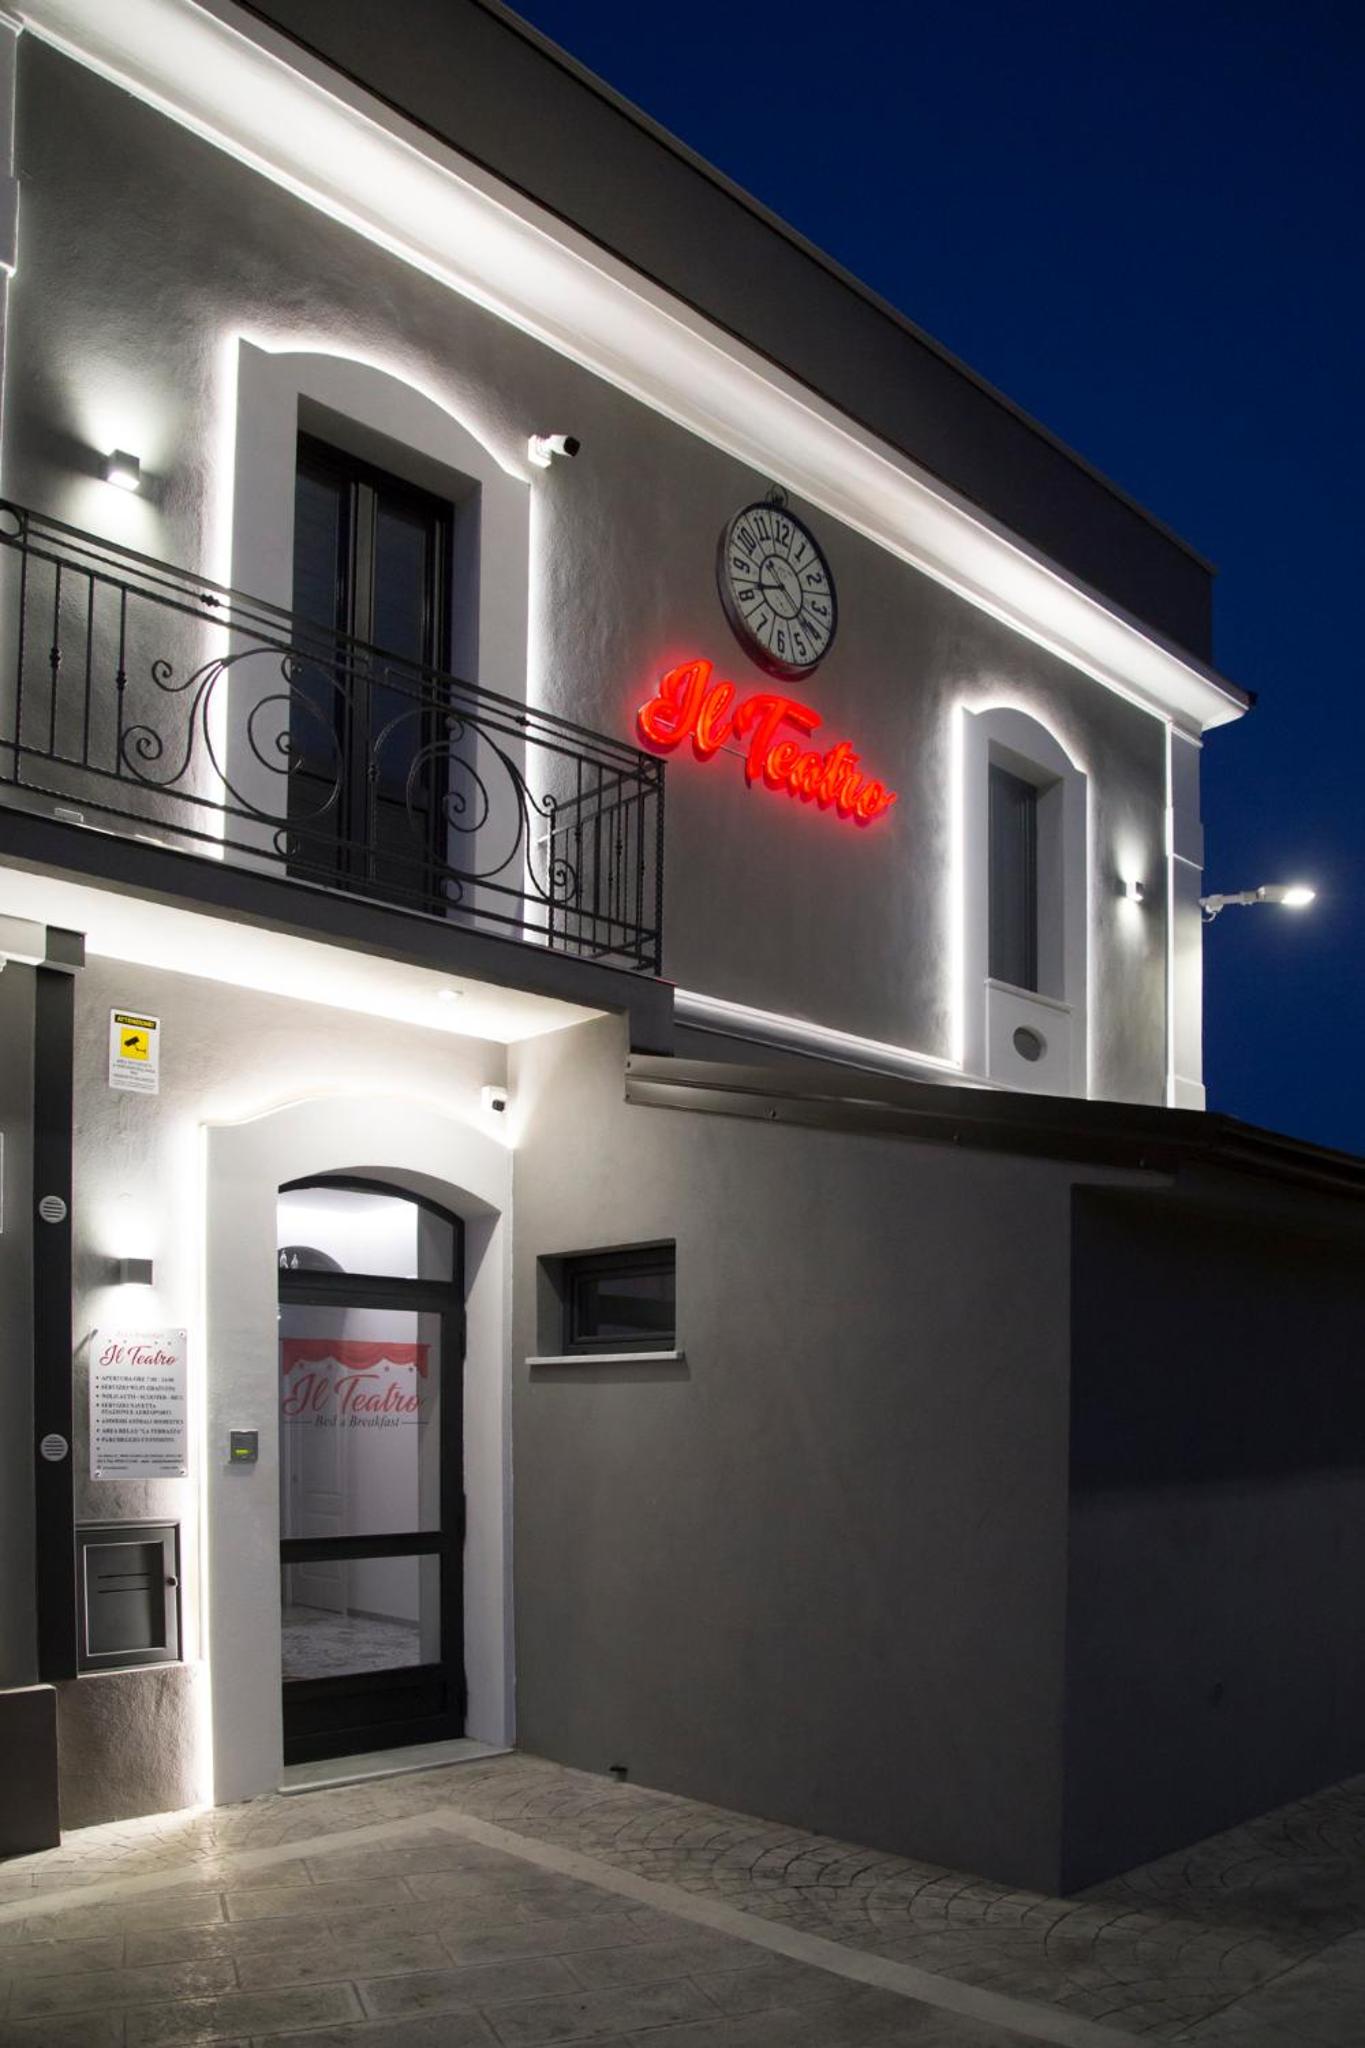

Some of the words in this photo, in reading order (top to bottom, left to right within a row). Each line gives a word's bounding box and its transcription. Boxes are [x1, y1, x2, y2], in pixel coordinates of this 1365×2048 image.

[753, 516, 772, 542] 11
[774, 518, 790, 549] 12
[737, 526, 757, 556] 10
[794, 541, 808, 563] 1
[732, 556, 751, 575] 9
[805, 571, 822, 587] 2
[738, 588, 755, 602] 8
[810, 599, 828, 619] 3
[756, 612, 769, 632] 7
[805, 620, 822, 642] 4
[777, 630, 786, 653] 6
[793, 632, 807, 656] 5
[637, 658, 737, 756] Il
[731, 693, 897, 821] Teatro
[99, 1344, 124, 1366] Il
[127, 1345, 176, 1366] Teatro
[282, 1373, 328, 1416] Il
[334, 1374, 424, 1415] Teatro
[314, 1414, 337, 1427] Bed
[350, 1414, 400, 1430] Breakfast
